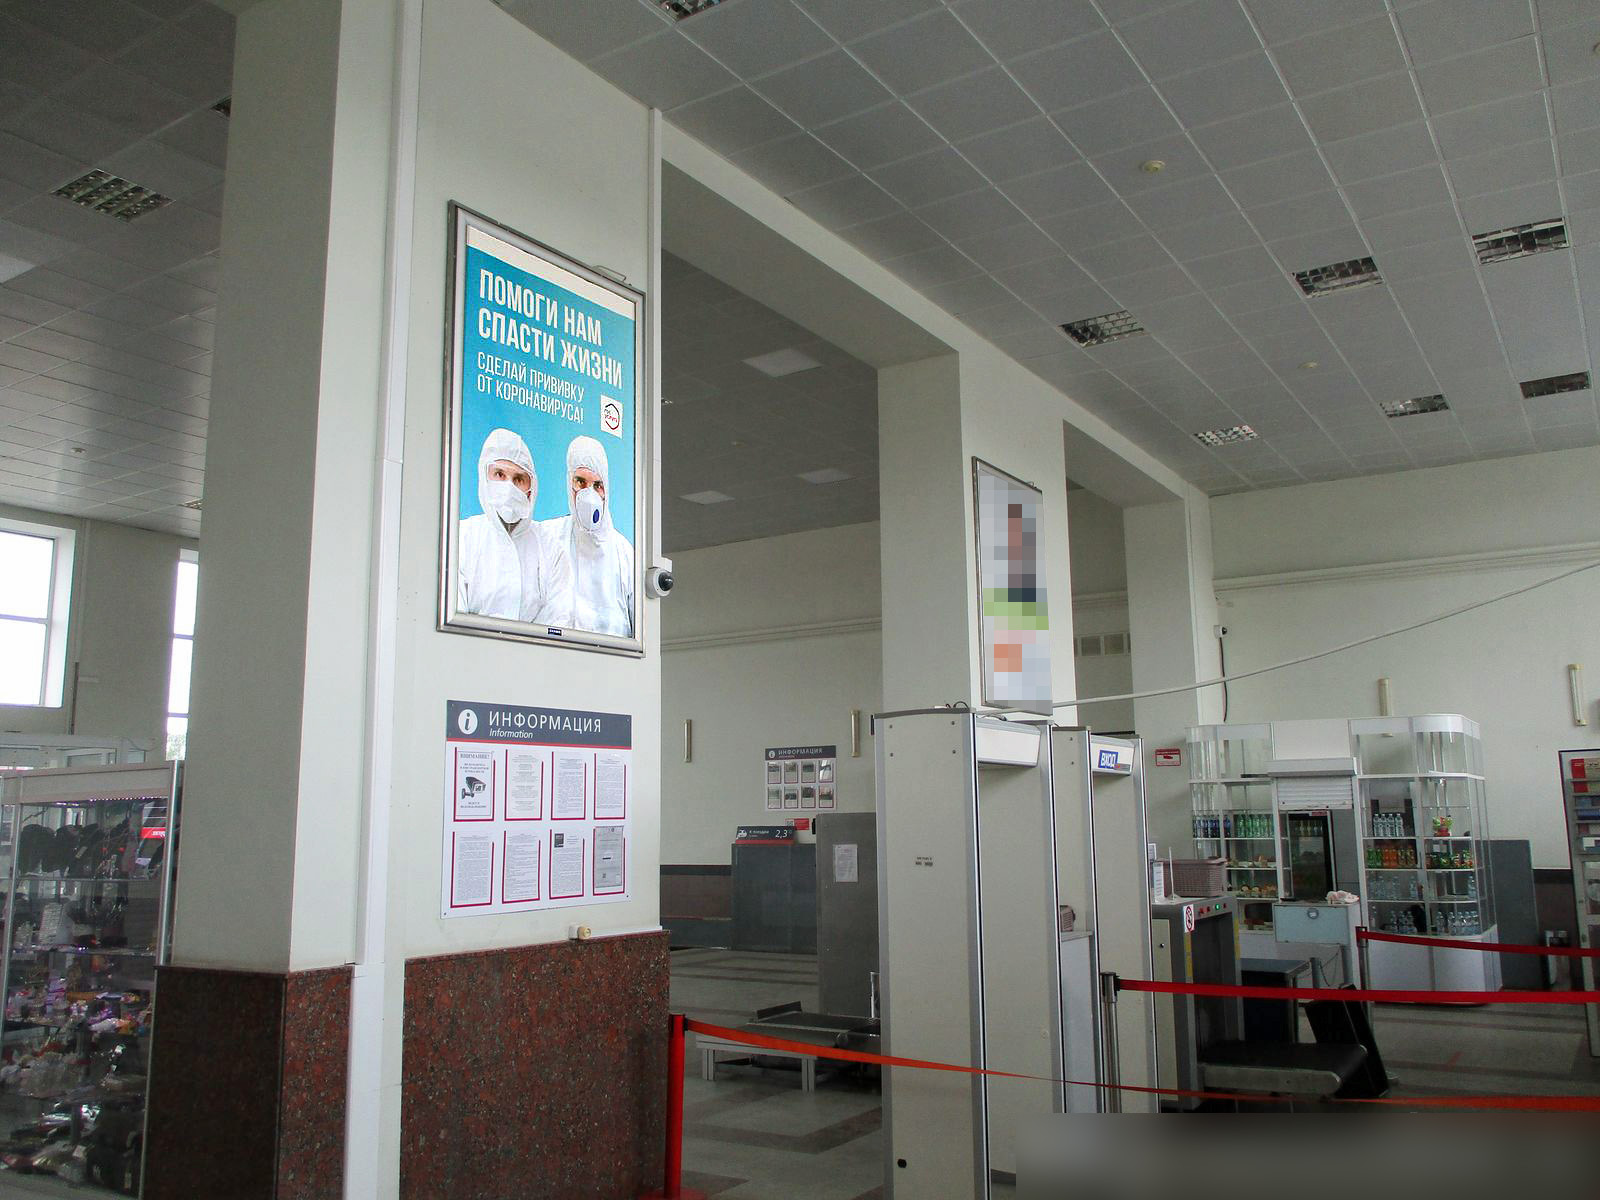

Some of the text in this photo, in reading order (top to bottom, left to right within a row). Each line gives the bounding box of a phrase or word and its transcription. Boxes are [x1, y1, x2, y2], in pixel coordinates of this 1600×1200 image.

[480, 268, 602, 346] ПОМОГИ НАМ
[478, 307, 623, 389] СПАСТИ ЖИЗНИ
[477, 351, 585, 403] СДЕЛАЙ ПРИВИВКУ
[477, 374, 493, 393] ОТ
[495, 381, 584, 425] КОРОНАВИРУСА!
[489, 710, 601, 734] ИНФОРМАЦИЯ
[489, 728, 534, 739] Information
[778, 747, 823, 756] ИНФОРМАЦИЯ
